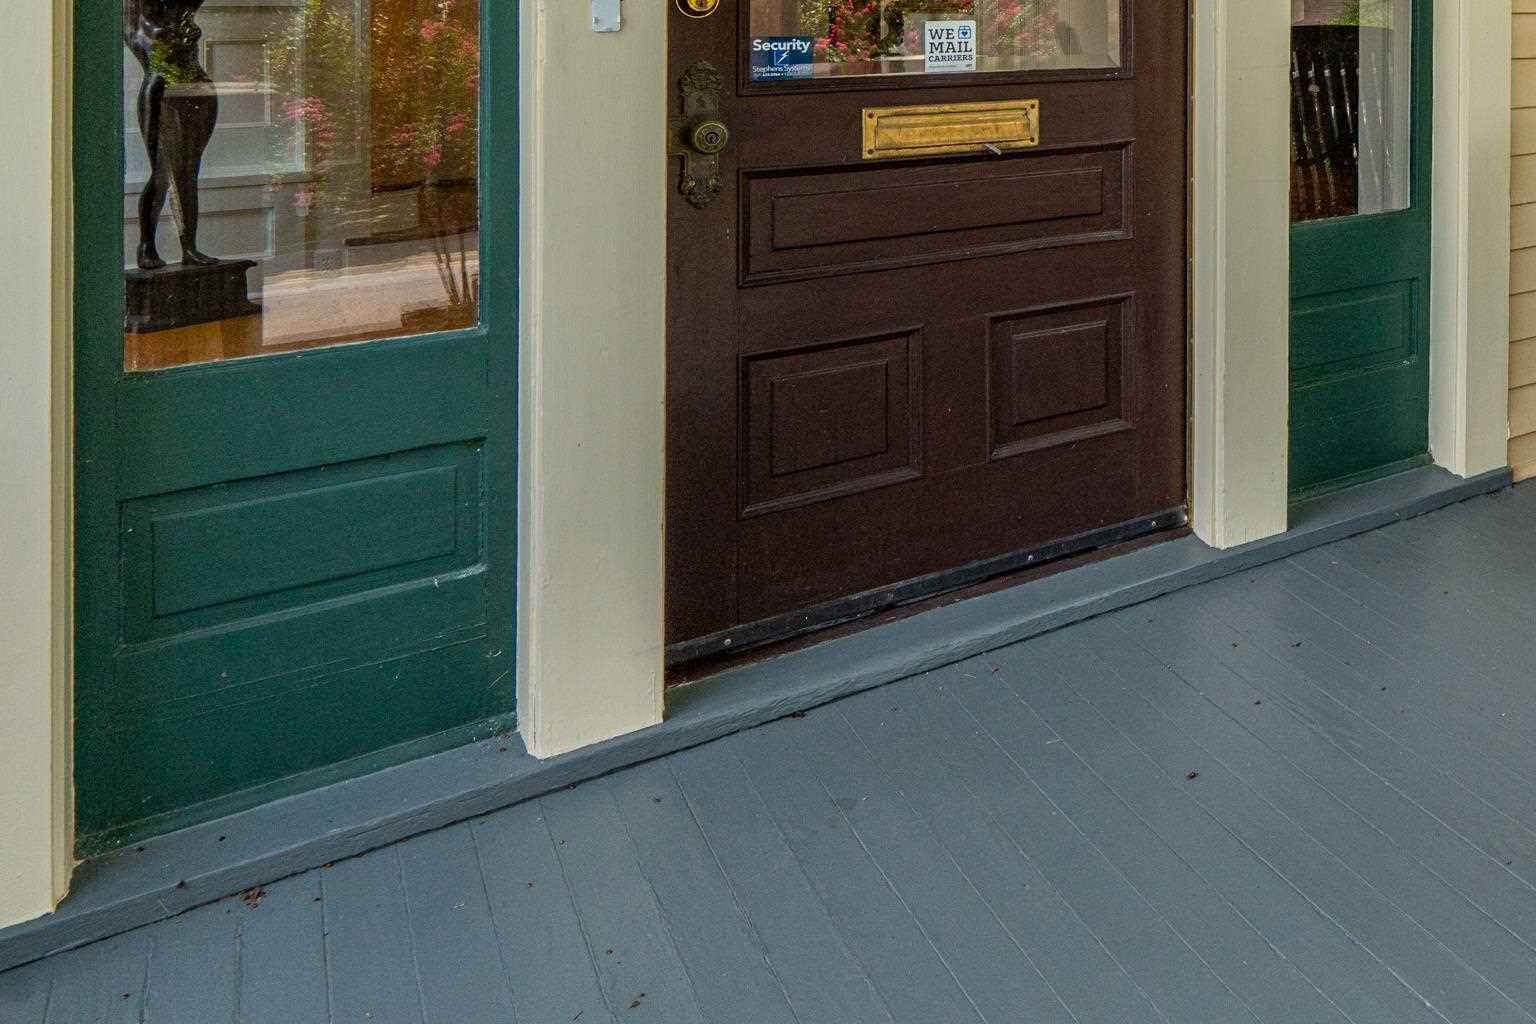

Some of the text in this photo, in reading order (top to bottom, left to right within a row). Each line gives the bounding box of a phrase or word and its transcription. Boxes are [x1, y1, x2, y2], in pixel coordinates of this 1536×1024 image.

[928, 28, 955, 40] WE
[752, 38, 811, 54] Security
[929, 41, 972, 54] MAIL
[928, 55, 973, 63] CARRIERS
